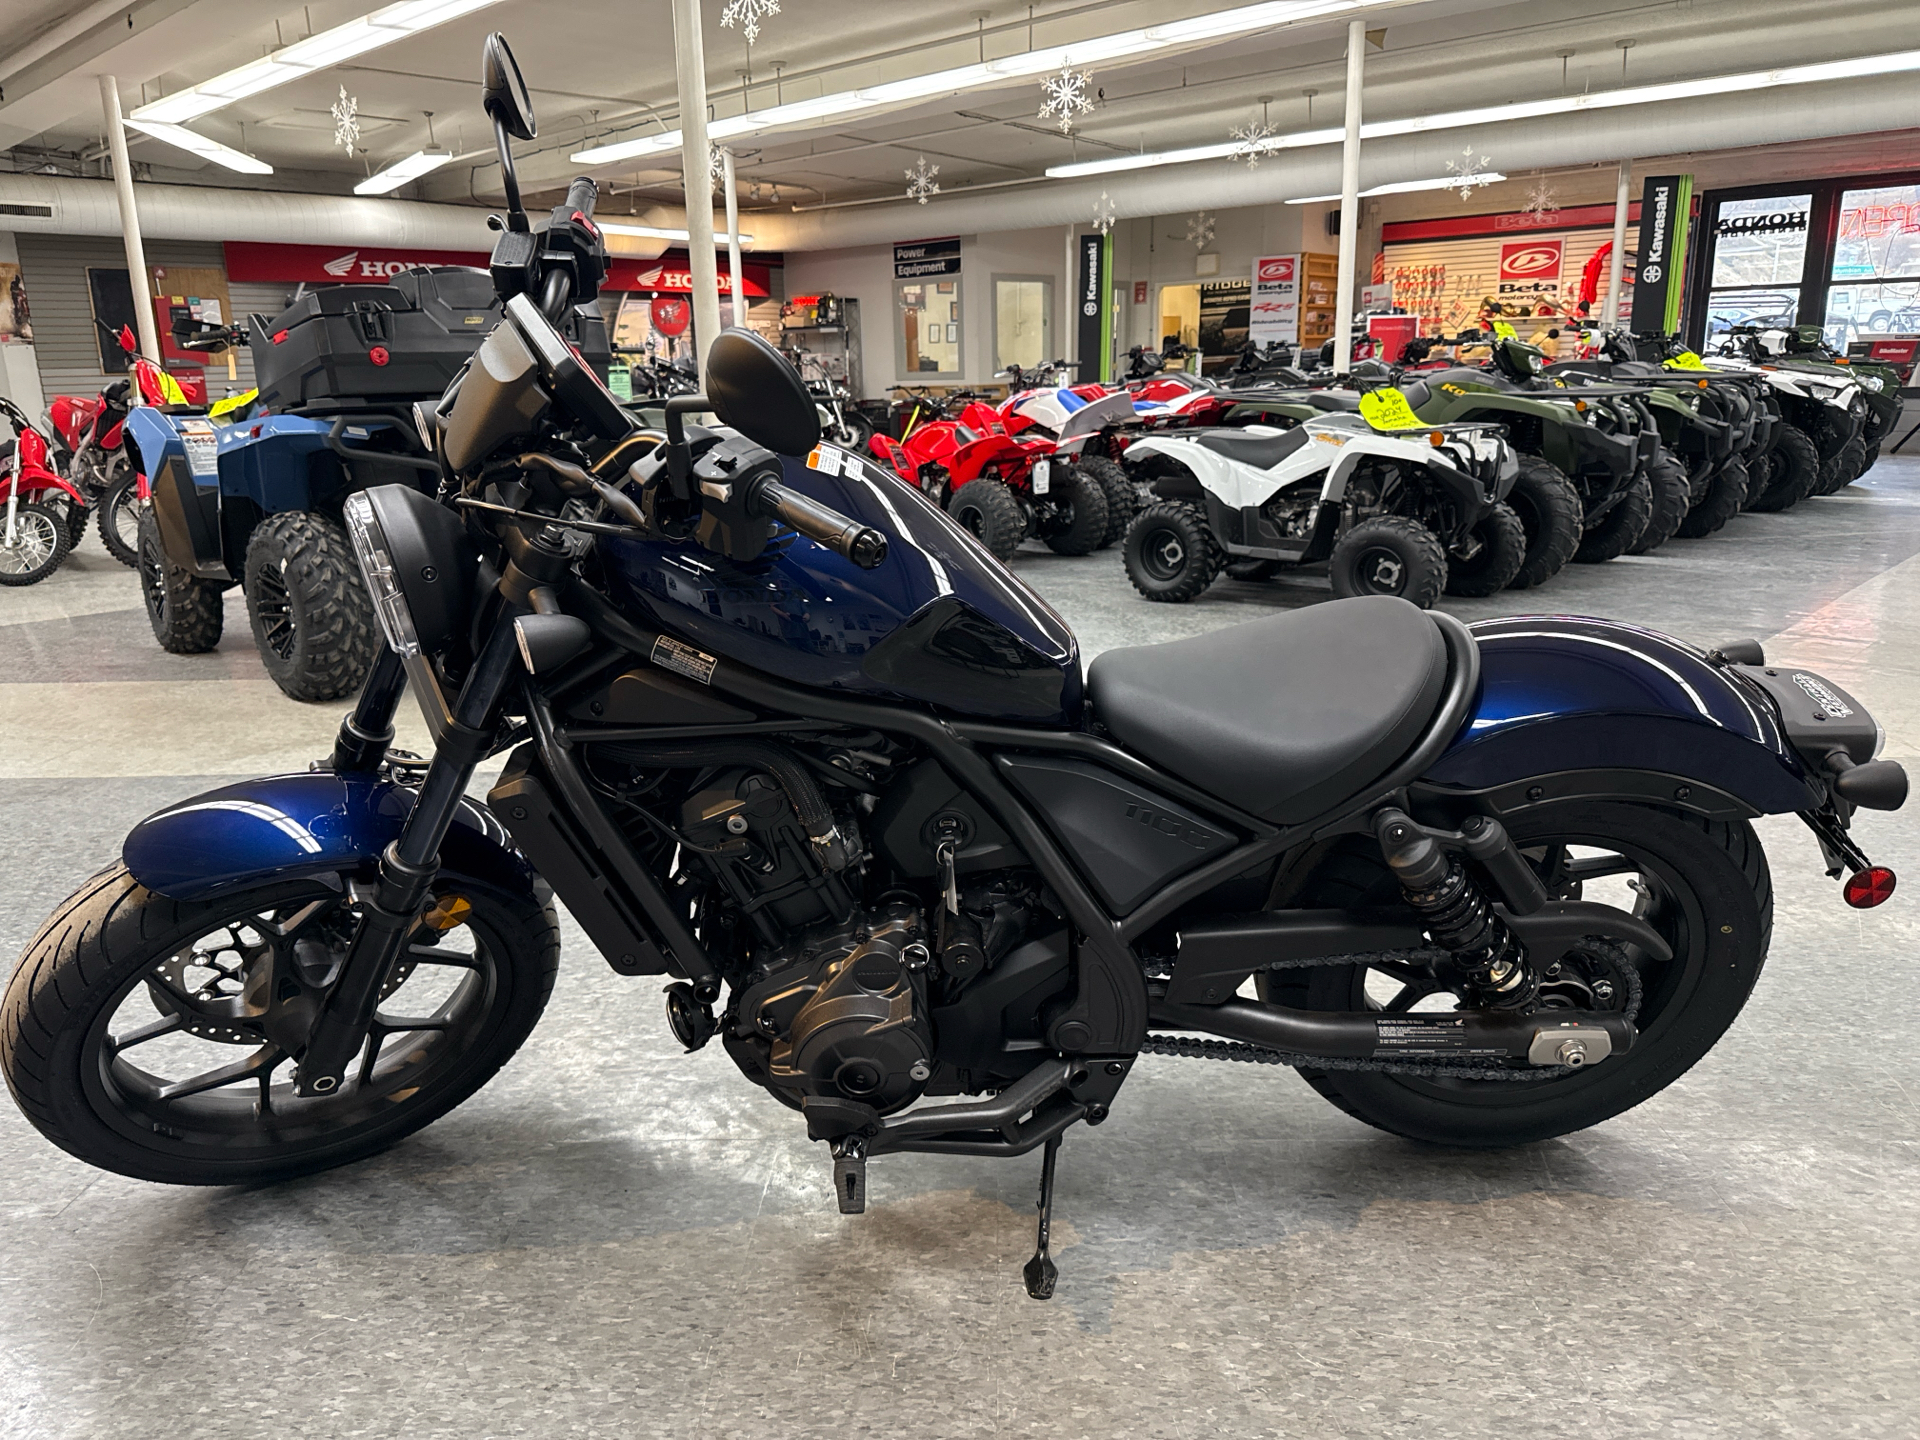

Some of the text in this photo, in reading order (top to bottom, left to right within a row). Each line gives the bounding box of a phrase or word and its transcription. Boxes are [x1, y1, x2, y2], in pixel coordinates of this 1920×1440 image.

[1495, 213, 1558, 229] Beta
[1648, 186, 1669, 262] Kawasaki
[897, 248, 926, 259] Power
[898, 261, 946, 276] Equipment
[1087, 242, 1097, 300] Kawasaki
[1258, 283, 1293, 291] Beta
[1499, 283, 1557, 294] Beta
